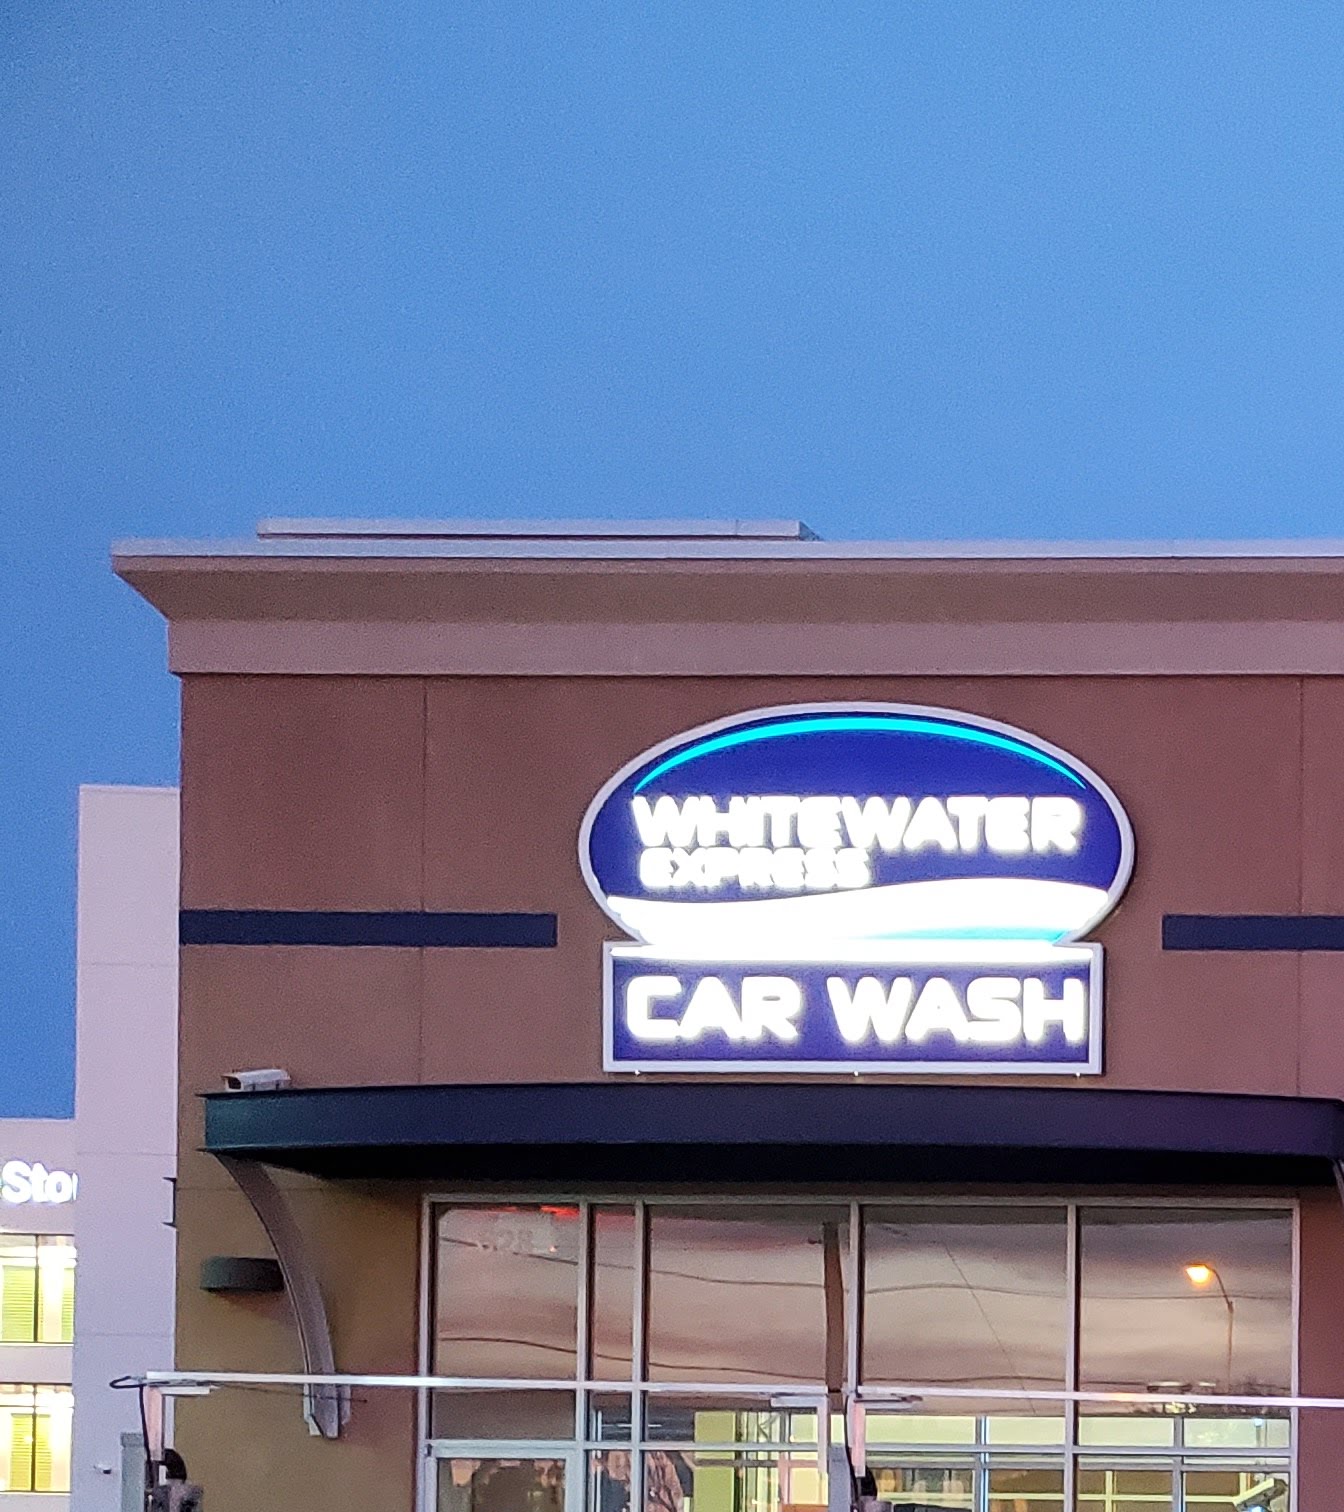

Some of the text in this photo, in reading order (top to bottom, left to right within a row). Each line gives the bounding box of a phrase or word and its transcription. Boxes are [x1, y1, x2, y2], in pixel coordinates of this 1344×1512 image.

[633, 795, 1081, 851] WHITEWATER
[638, 847, 872, 889] EXPRESS
[627, 976, 1087, 1042] CAR WASH
